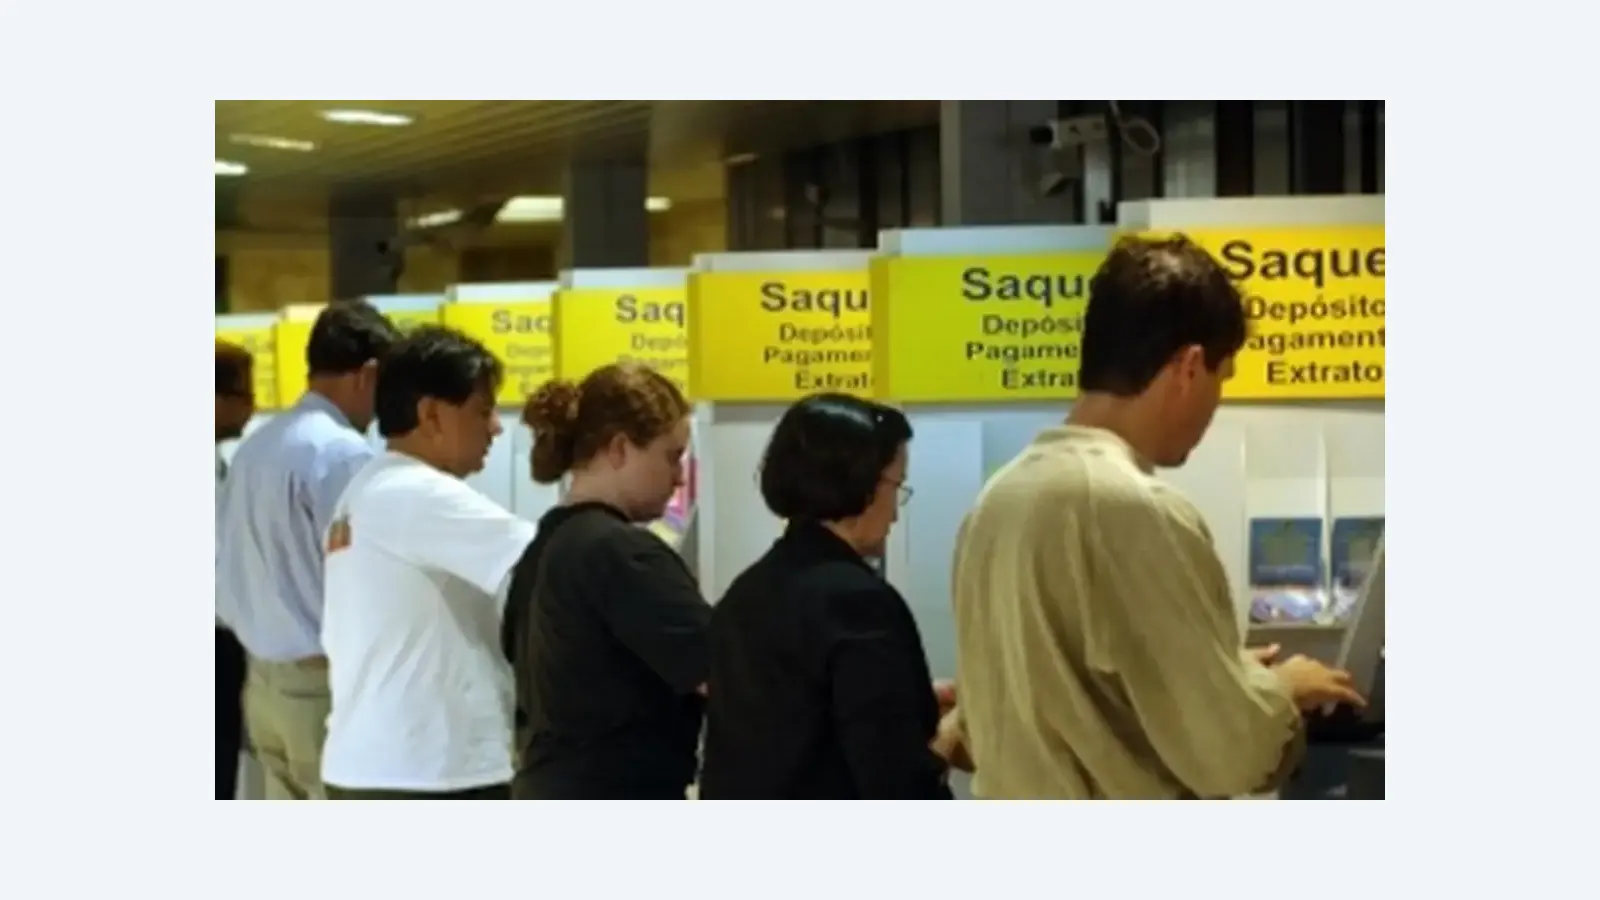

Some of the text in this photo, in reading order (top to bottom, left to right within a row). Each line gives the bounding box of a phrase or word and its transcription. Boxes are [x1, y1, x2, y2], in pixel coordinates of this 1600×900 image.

[1221, 239, 1385, 288] Saque
[615, 293, 684, 328] Saq
[760, 281, 868, 318] Saqu
[1247, 327, 1385, 354] agament
[1266, 360, 1382, 385] Extrato
